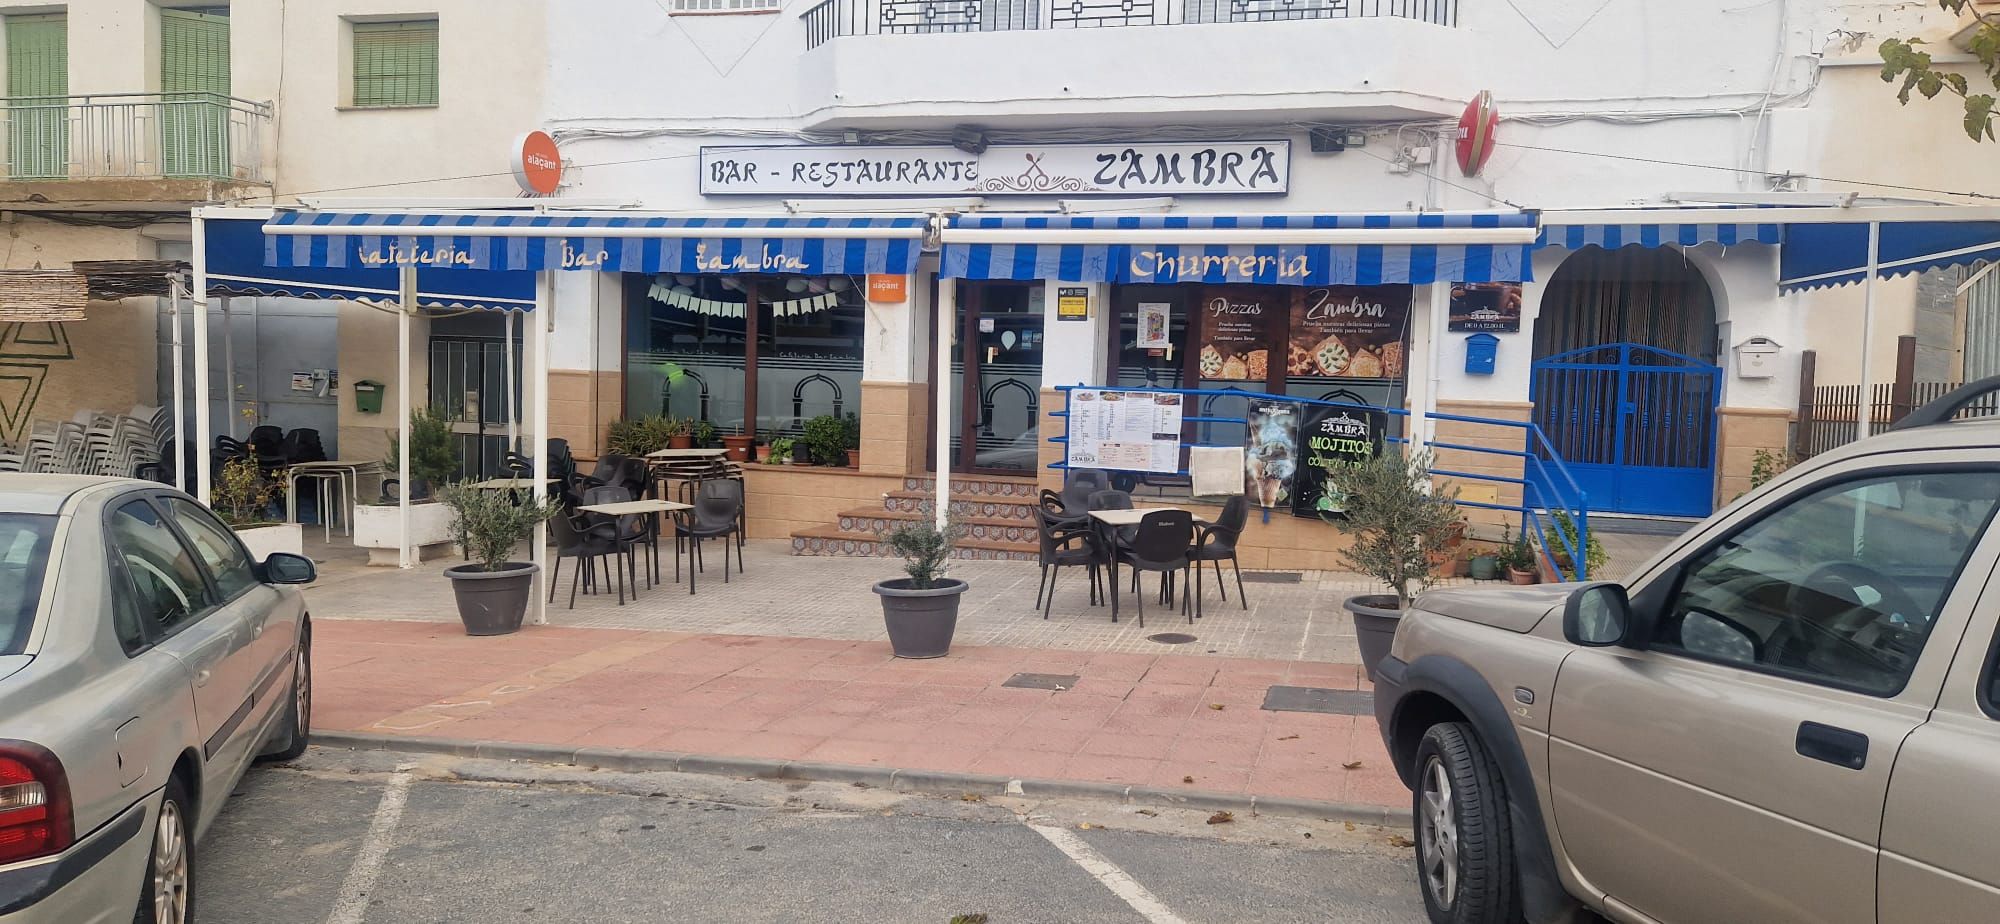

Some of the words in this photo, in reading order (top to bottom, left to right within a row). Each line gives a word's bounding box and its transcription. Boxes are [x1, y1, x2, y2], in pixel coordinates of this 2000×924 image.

[527, 154, 556, 170] alaçant
[710, 160, 758, 184] BAR
[791, 158, 979, 188] RESTAURANTE
[1093, 146, 1279, 189] ZAMBRA
[560, 239, 608, 268] Bar
[1131, 248, 1312, 279] Churreria
[1209, 297, 1263, 318] Pizzas
[1306, 288, 1387, 320] Zambra
[1320, 423, 1366, 436] ZAMBRA
[1311, 436, 1373, 455] MOJITOS
